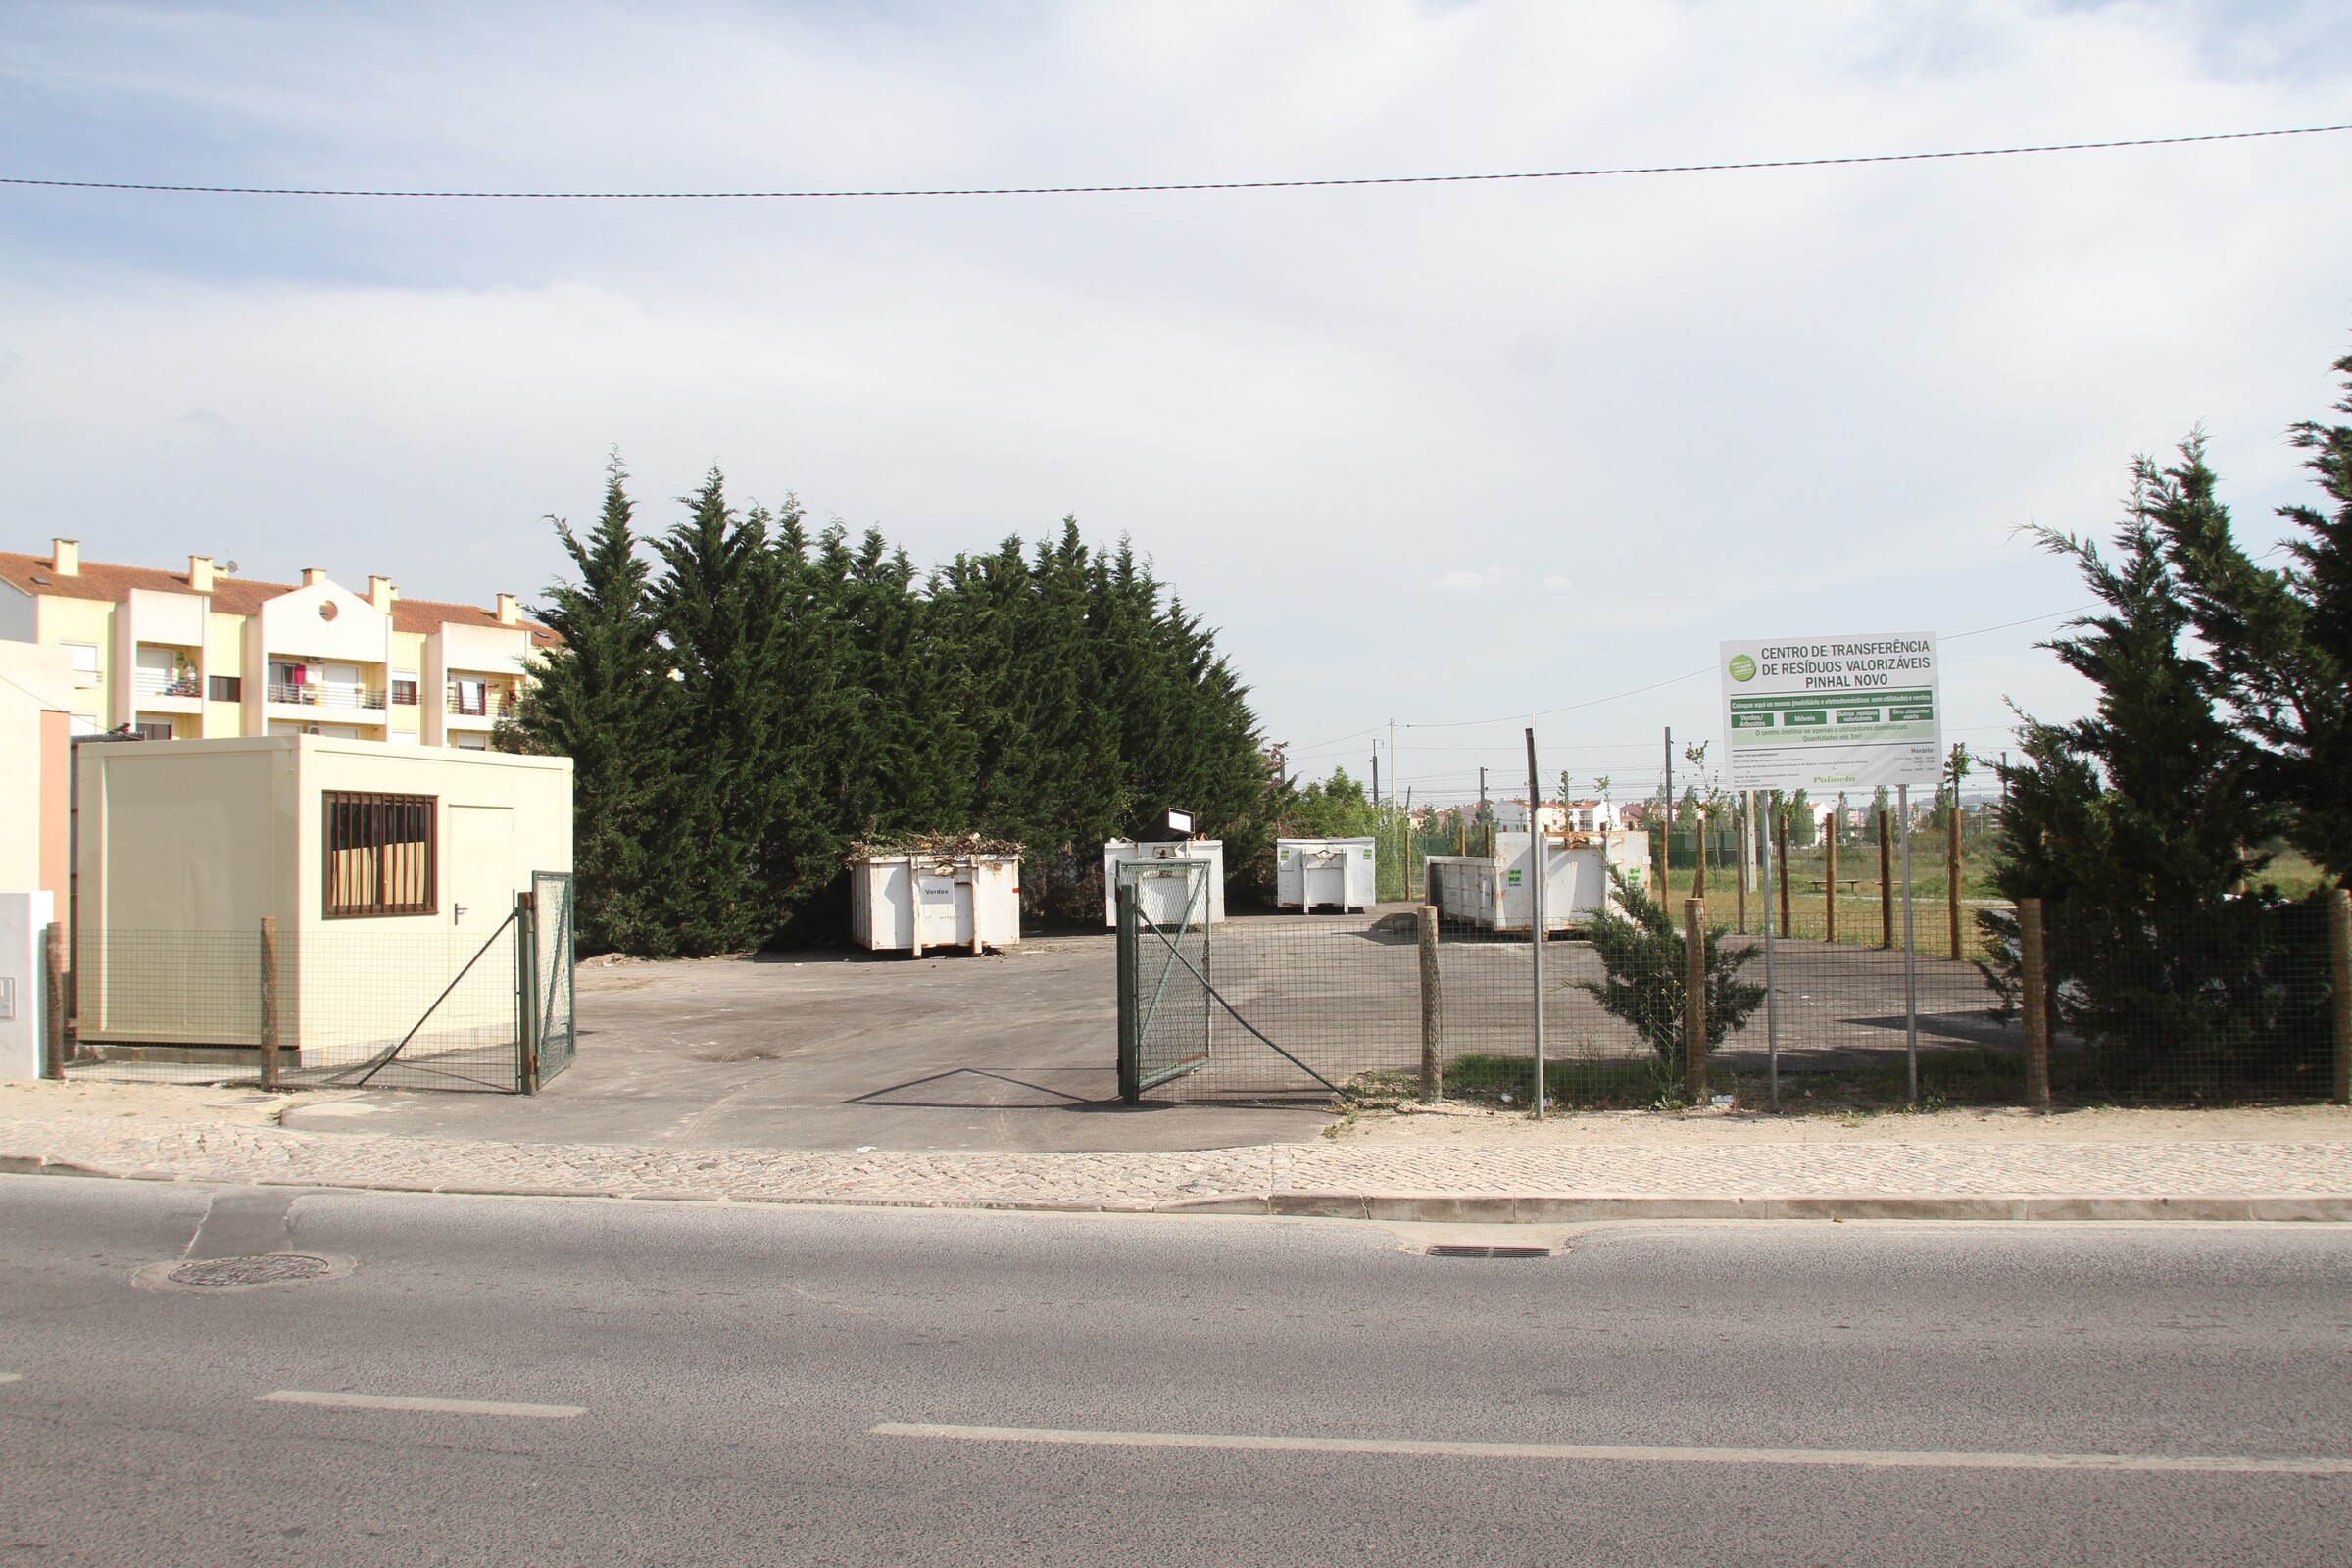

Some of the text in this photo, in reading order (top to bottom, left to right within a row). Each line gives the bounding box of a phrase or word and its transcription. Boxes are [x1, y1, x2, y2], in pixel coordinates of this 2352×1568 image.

[1761, 639, 1930, 660] CENTRO DE TRANSFERÊNCIA
[1762, 655, 1930, 675] DE RESÍDUOS VALORIZÁVEIS
[1805, 674, 1887, 688] PINHAL NOVO
